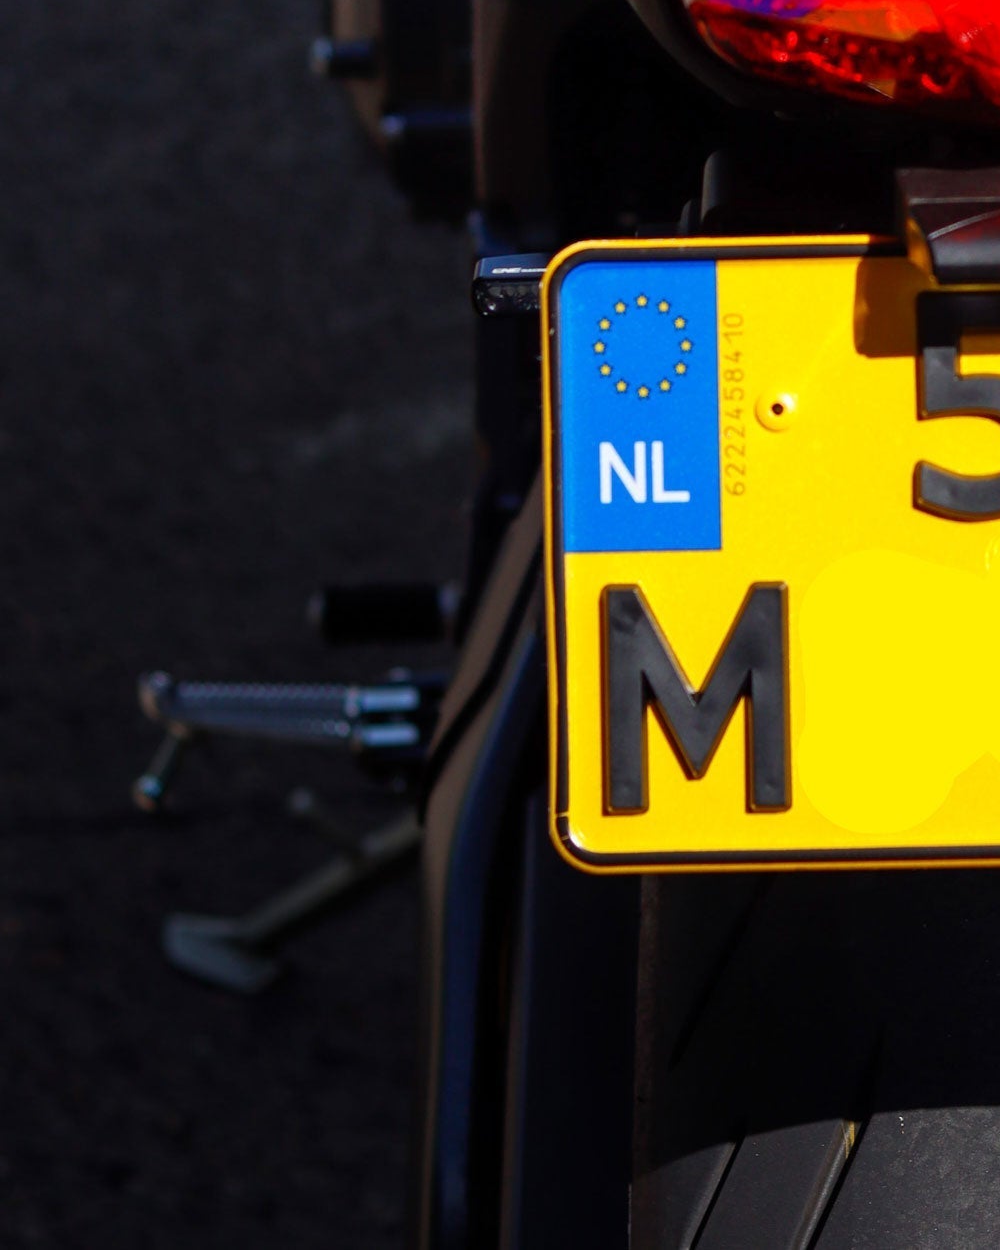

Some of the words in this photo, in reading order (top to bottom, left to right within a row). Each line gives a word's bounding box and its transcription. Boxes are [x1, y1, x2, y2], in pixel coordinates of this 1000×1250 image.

[599, 440, 690, 504] NL
[722, 312, 747, 496] 6222458410
[600, 581, 791, 816] M
